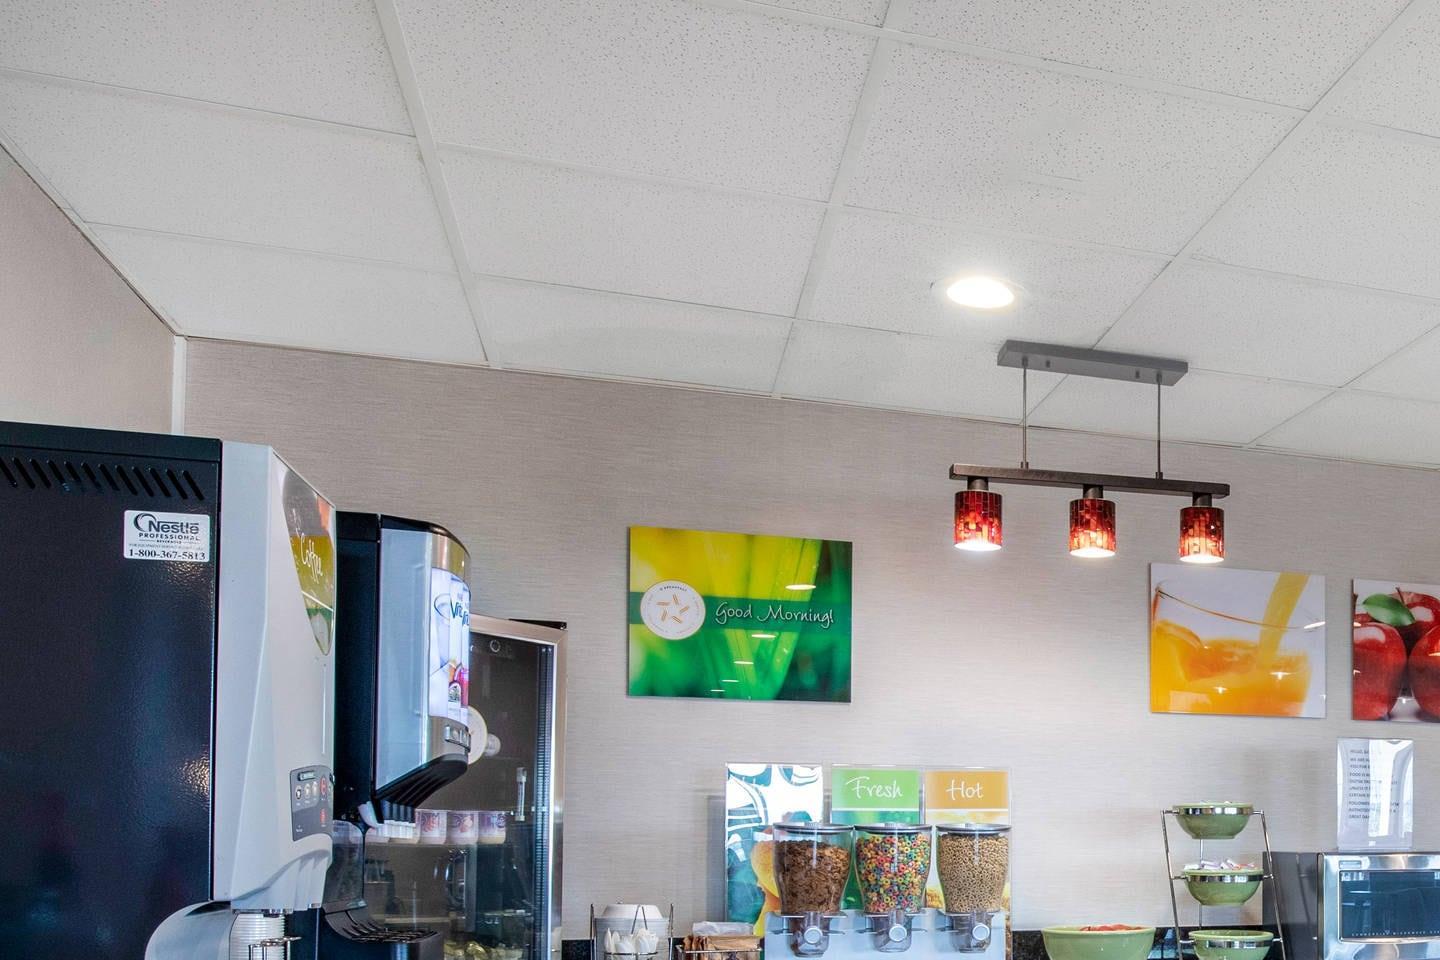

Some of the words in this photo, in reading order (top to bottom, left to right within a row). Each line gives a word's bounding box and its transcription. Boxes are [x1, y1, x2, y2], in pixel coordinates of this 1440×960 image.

[139, 532, 201, 541] PROFESSIONAL
[129, 548, 206, 560] 1-800-367-5813
[715, 601, 753, 624] Good
[756, 604, 834, 629] Morning!
[845, 775, 904, 800] Fresh
[945, 778, 984, 801] Hot
